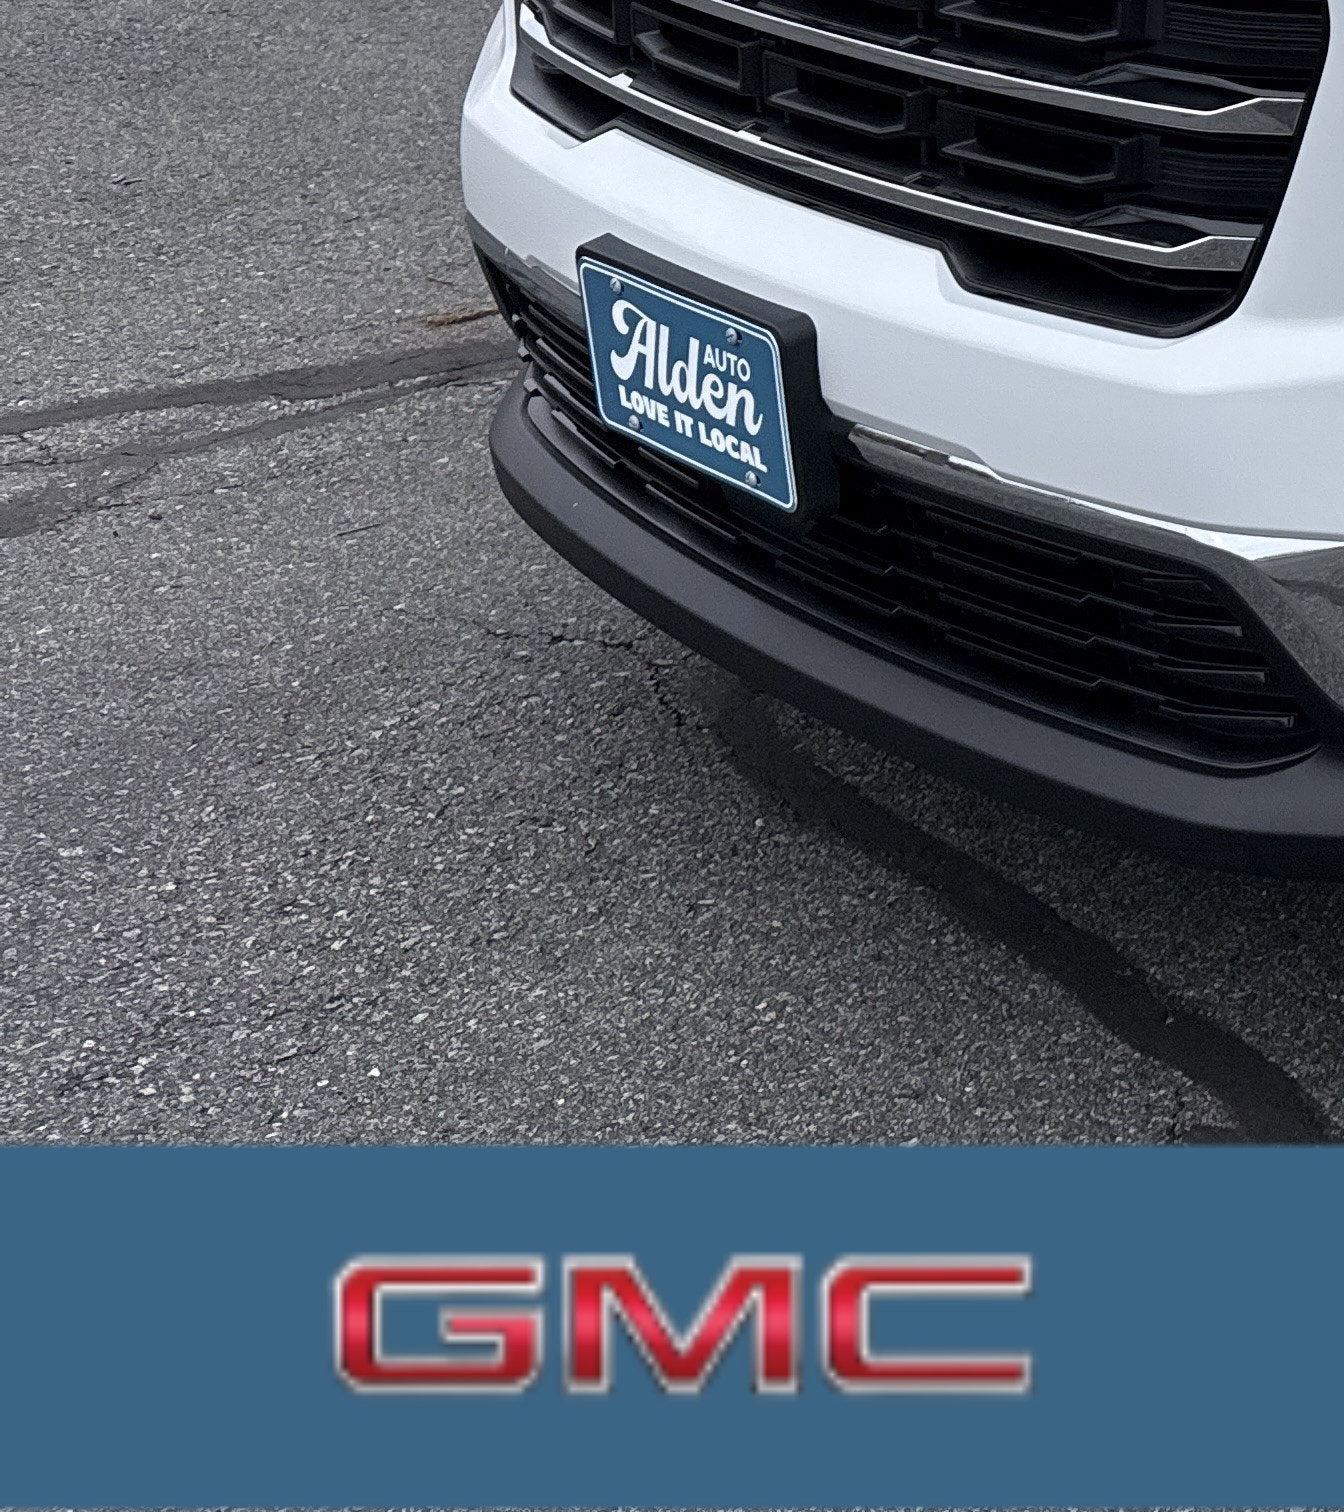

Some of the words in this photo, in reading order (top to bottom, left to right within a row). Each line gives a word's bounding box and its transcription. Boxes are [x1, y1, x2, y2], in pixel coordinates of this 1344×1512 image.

[610, 299, 764, 436] Alden
[703, 344, 750, 382] AUTO
[618, 384, 670, 428] LOVE
[674, 410, 694, 438] IT
[698, 421, 768, 473] LOCAL
